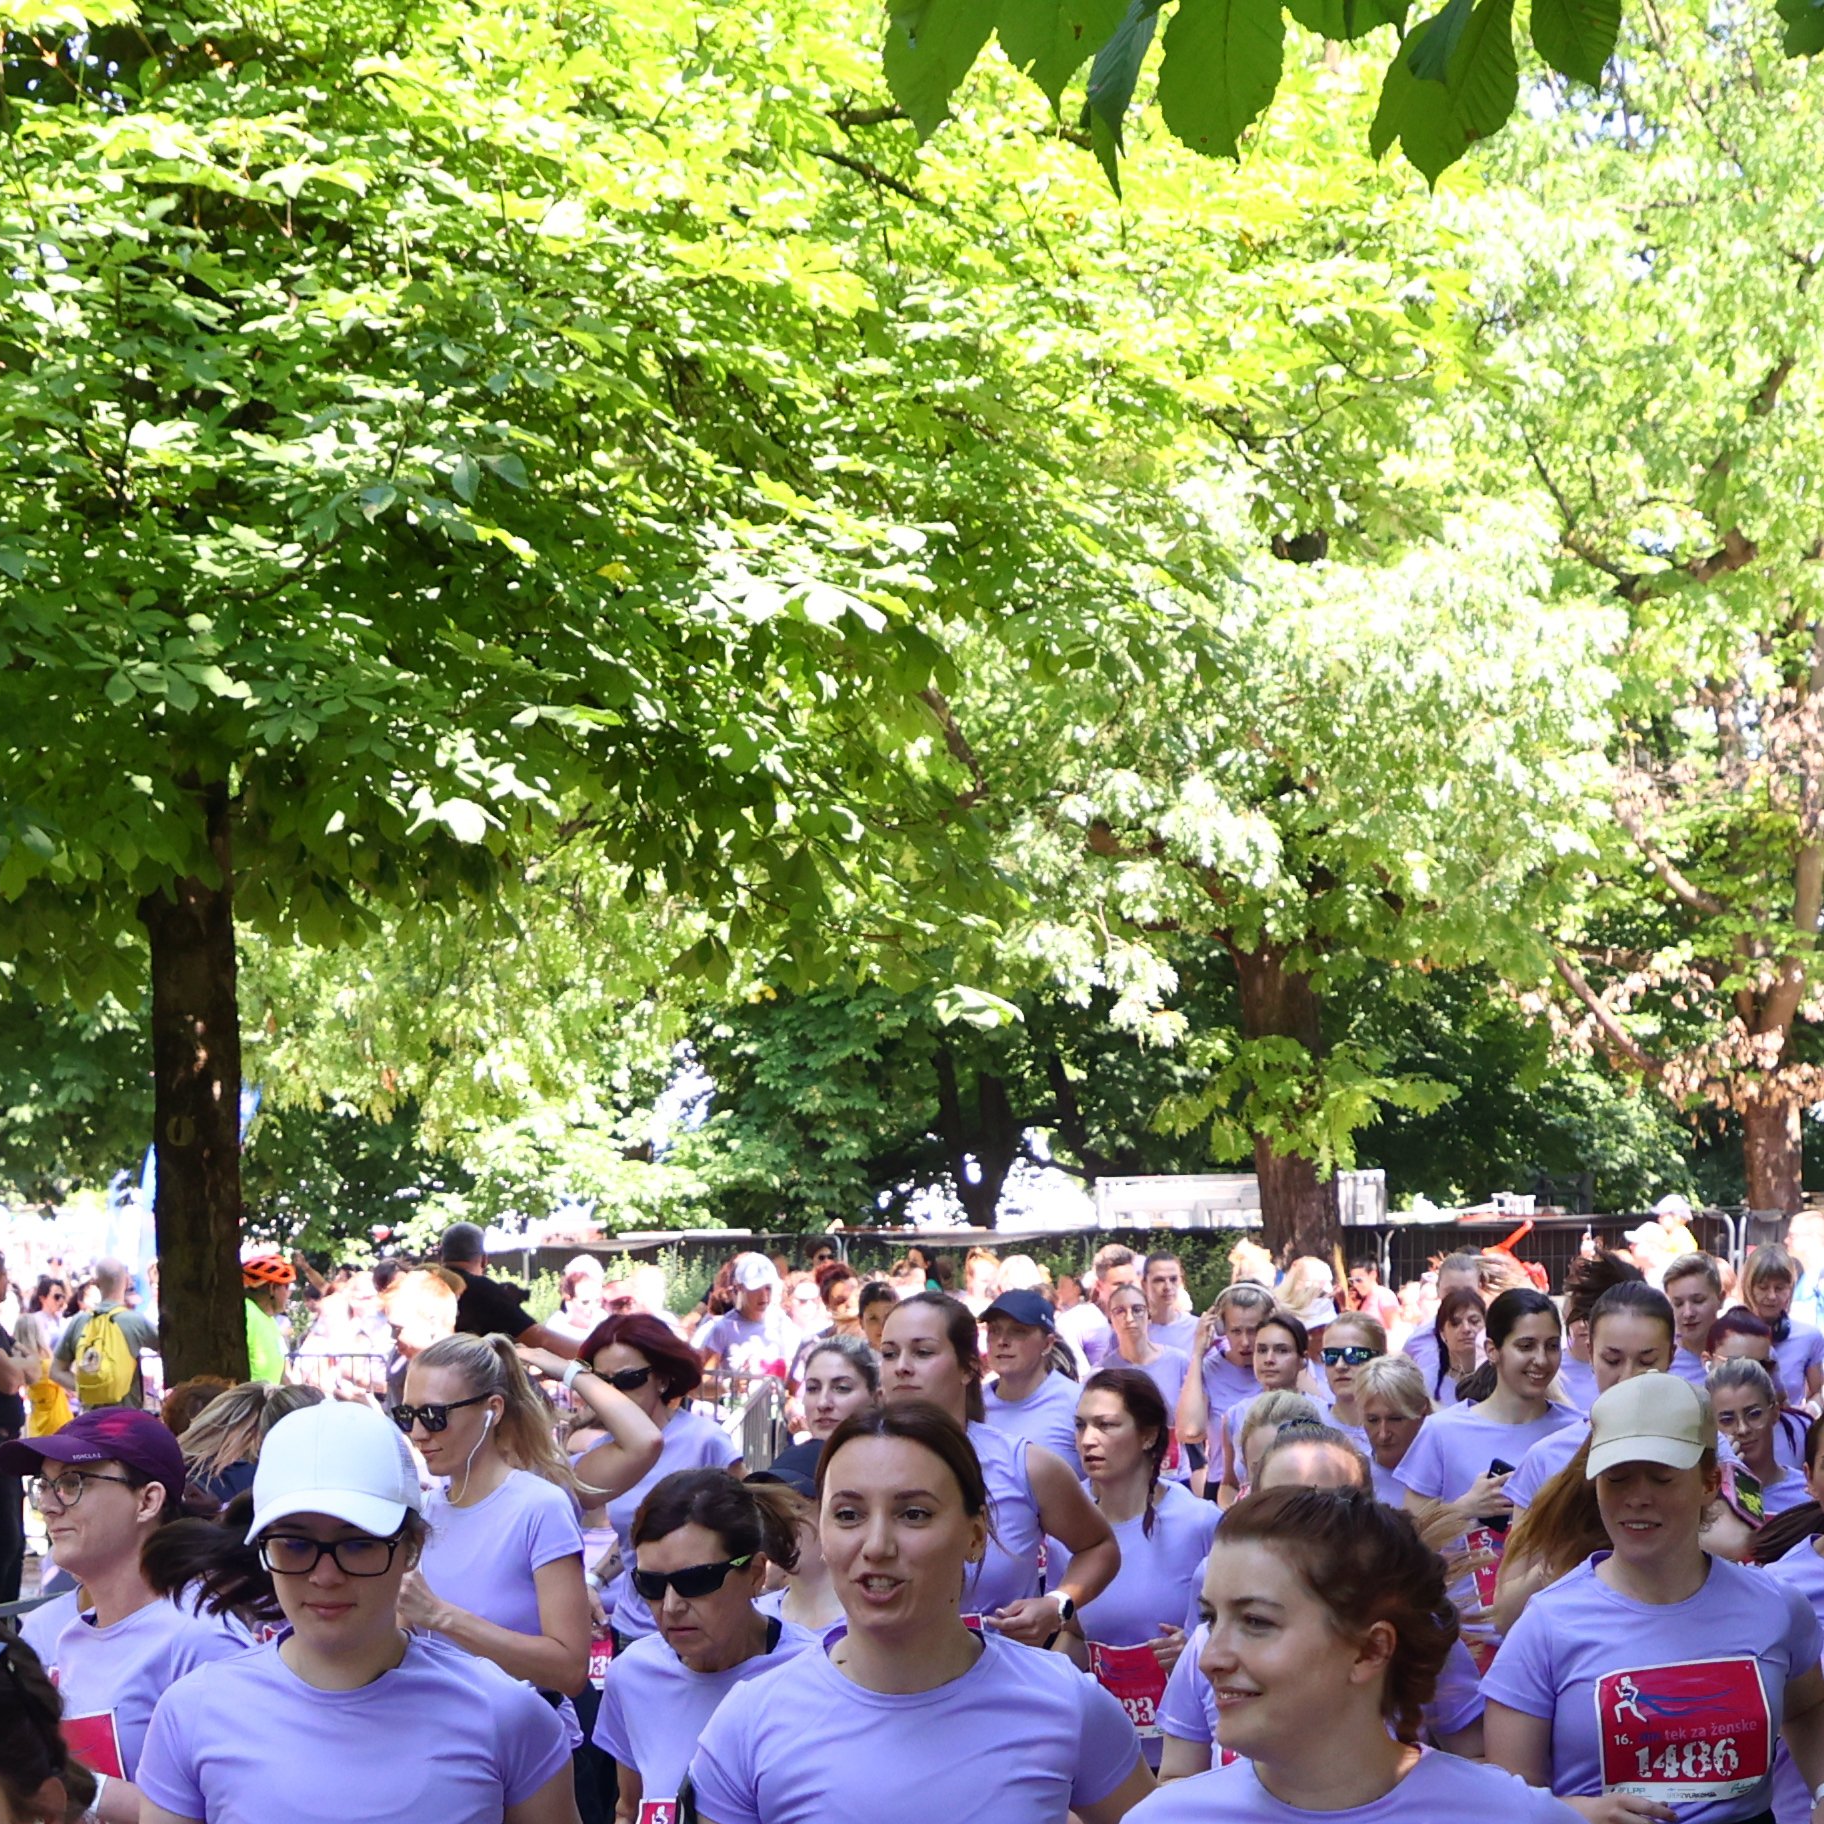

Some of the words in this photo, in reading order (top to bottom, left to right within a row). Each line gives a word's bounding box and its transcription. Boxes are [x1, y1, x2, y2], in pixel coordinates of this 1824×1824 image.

[1119, 1696, 1157, 1723] 33
[1614, 1734, 1633, 1746] 16.
[1665, 1729, 1687, 1740] tek
[1691, 1727, 1707, 1738] za
[1711, 1718, 1757, 1736] ženske
[1635, 1737, 1739, 1778] 1486
